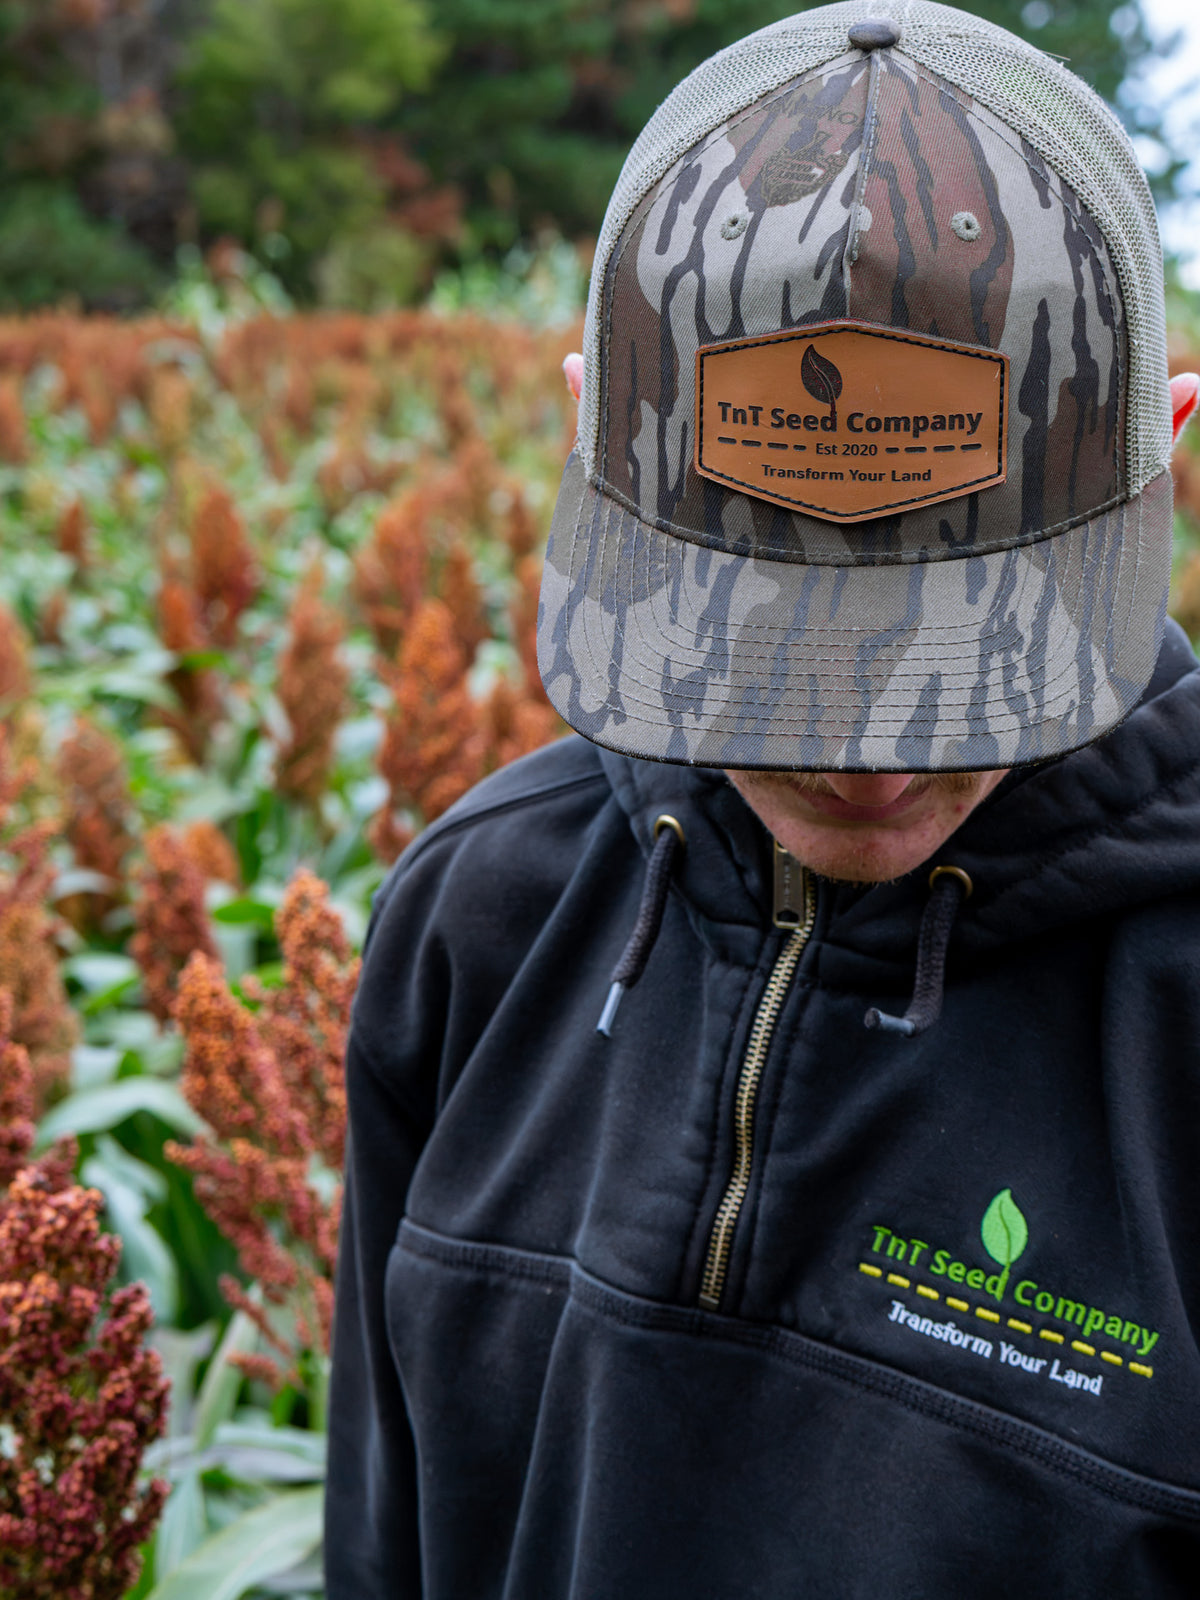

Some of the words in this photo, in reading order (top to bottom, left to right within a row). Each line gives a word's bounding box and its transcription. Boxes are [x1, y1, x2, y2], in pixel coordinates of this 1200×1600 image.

[717, 401, 763, 427] TnT
[770, 407, 837, 433] Seed
[846, 411, 983, 438] Company
[816, 443, 839, 456] Est
[841, 443, 878, 456] 2020
[761, 464, 844, 481] Transform
[849, 469, 886, 482] Your
[891, 469, 932, 482] Land
[872, 1225, 929, 1266] TnT
[930, 1249, 1010, 1302] Seed
[1014, 1280, 1159, 1356] Company
[888, 1300, 994, 1359] Transform
[1000, 1341, 1047, 1374] Your
[1049, 1359, 1104, 1396] Land
